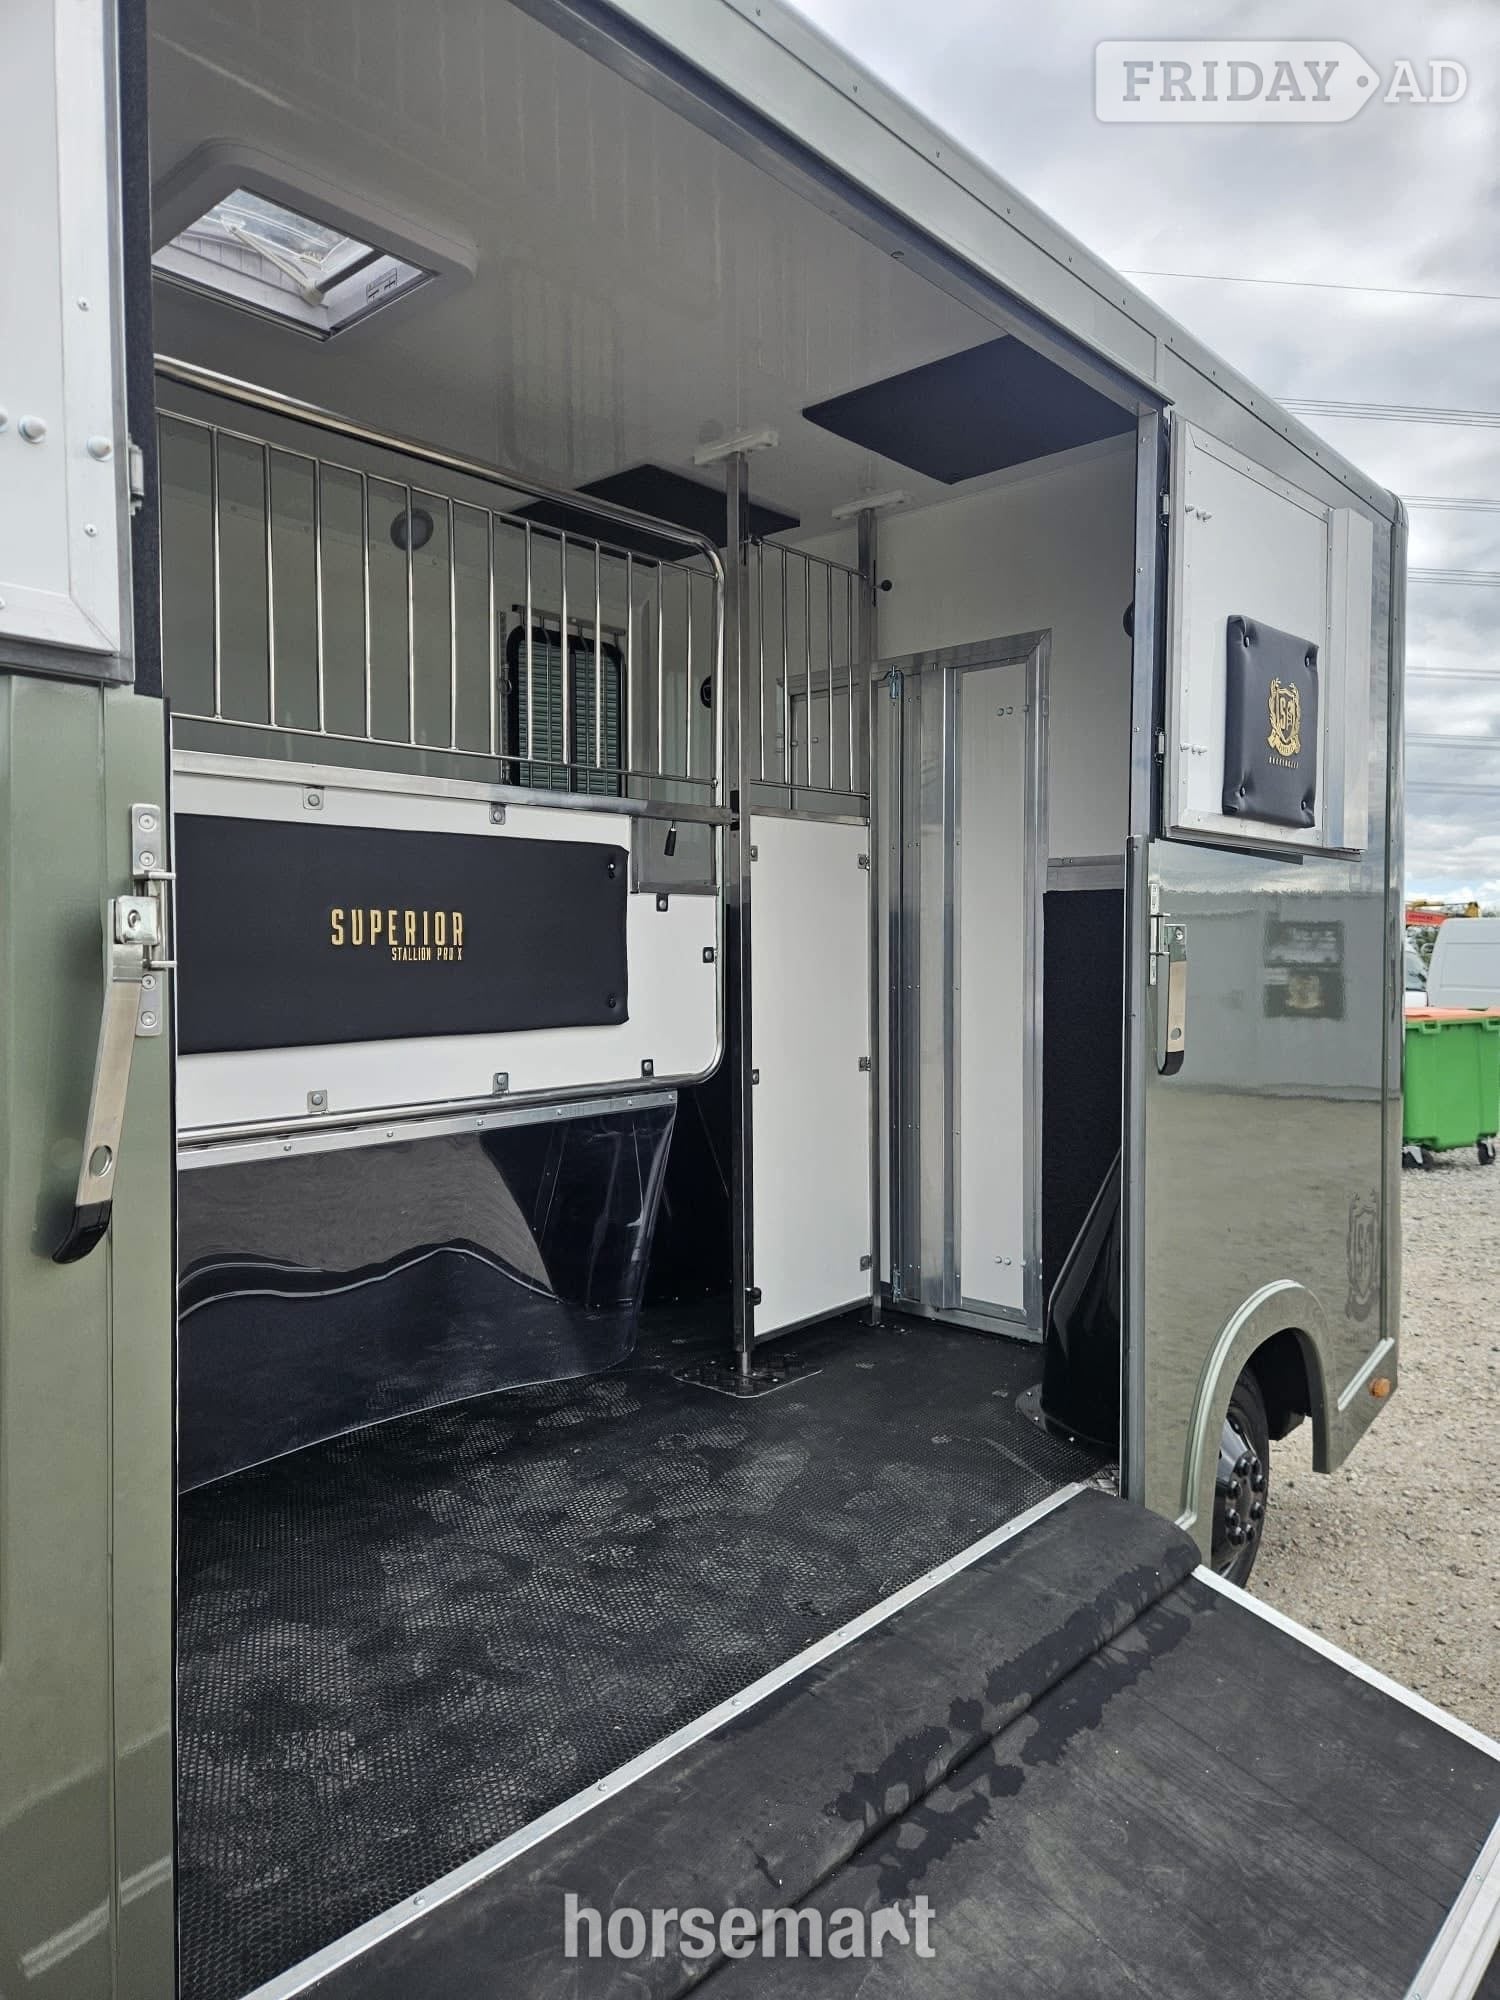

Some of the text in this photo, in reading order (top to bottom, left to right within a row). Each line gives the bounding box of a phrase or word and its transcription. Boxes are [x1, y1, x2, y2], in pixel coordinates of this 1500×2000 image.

[331, 908, 464, 946] SUPERIOR
[391, 946, 463, 961] STALLION PRO X
